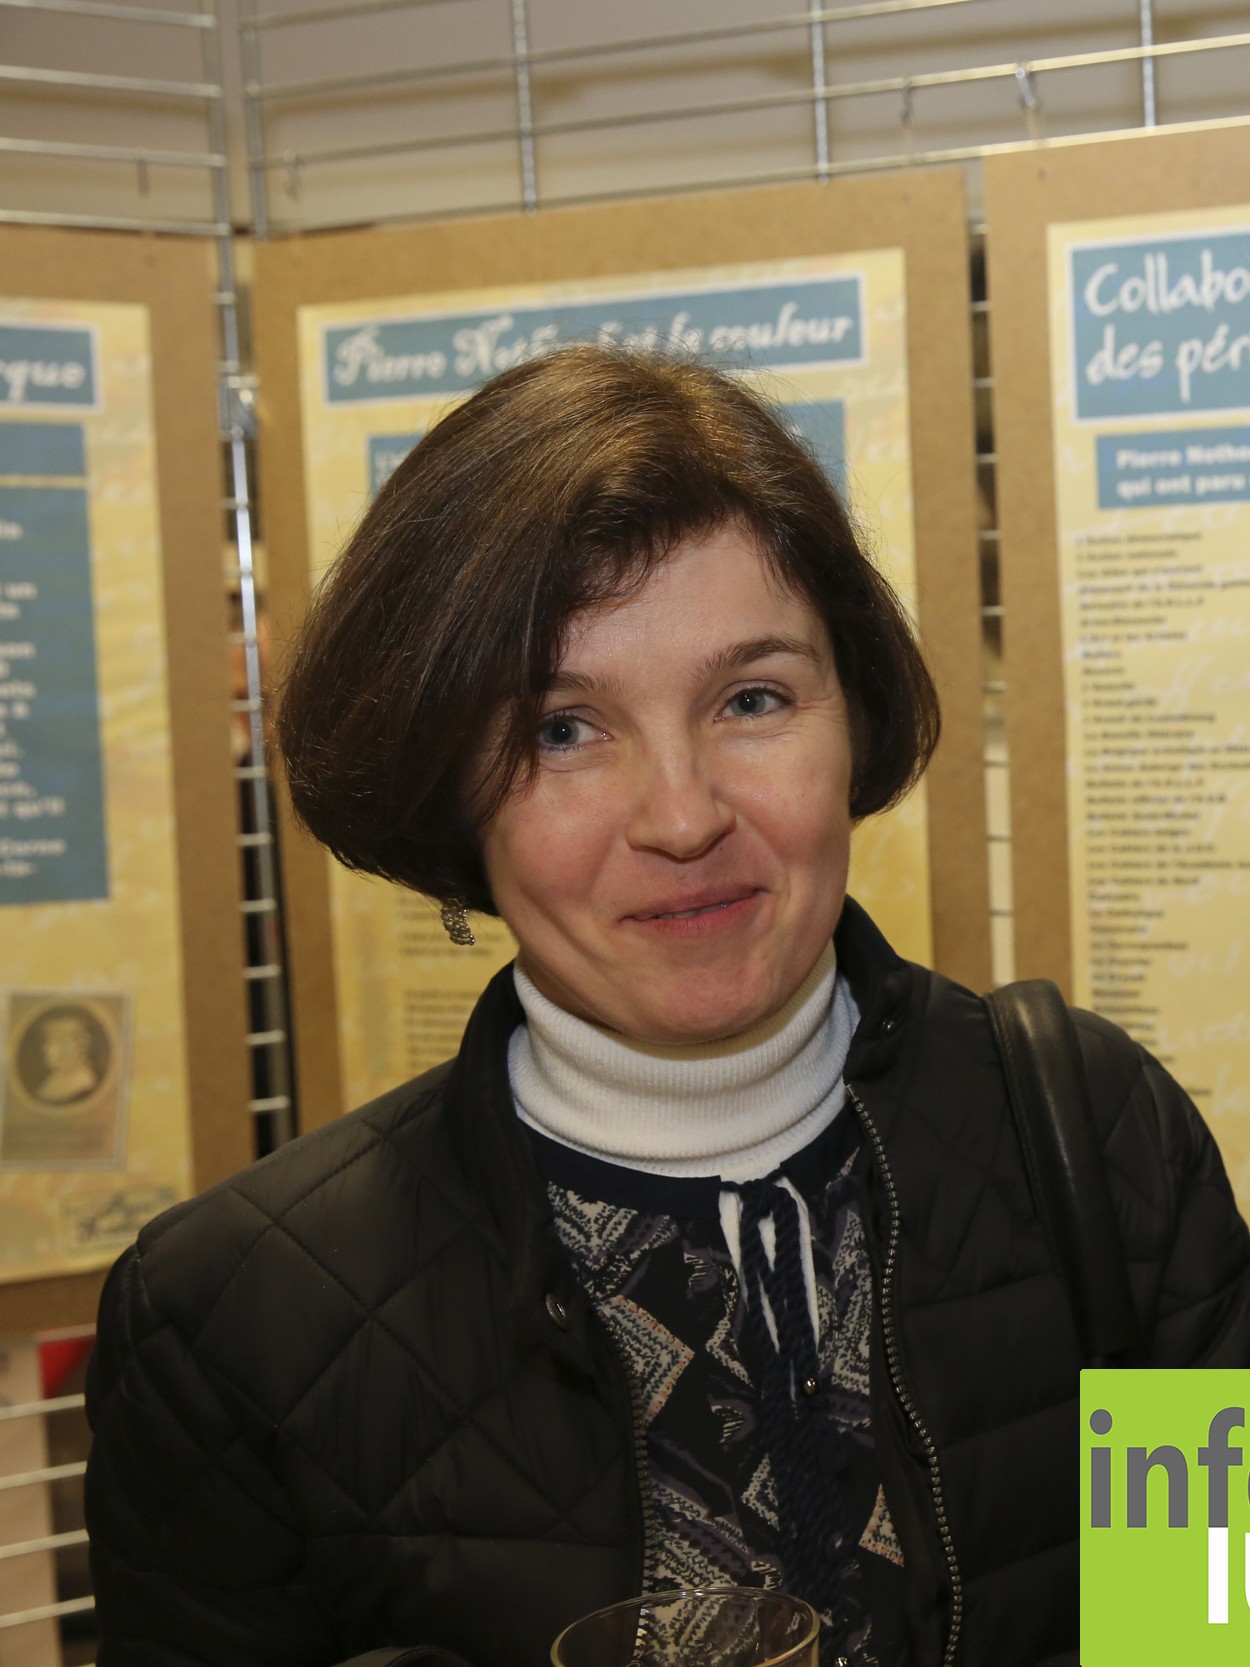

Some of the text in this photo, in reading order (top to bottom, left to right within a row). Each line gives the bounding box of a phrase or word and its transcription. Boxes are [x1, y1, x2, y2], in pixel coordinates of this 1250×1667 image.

[333, 325, 446, 386] Pierre
[709, 301, 853, 352] couleur
[1085, 323, 1163, 384] des
[0, 359, 86, 402] que
[1116, 448, 1182, 470] Pierre
[1117, 476, 1151, 500] qui
[1155, 473, 1191, 495] ont
[1195, 472, 1245, 497] paru
